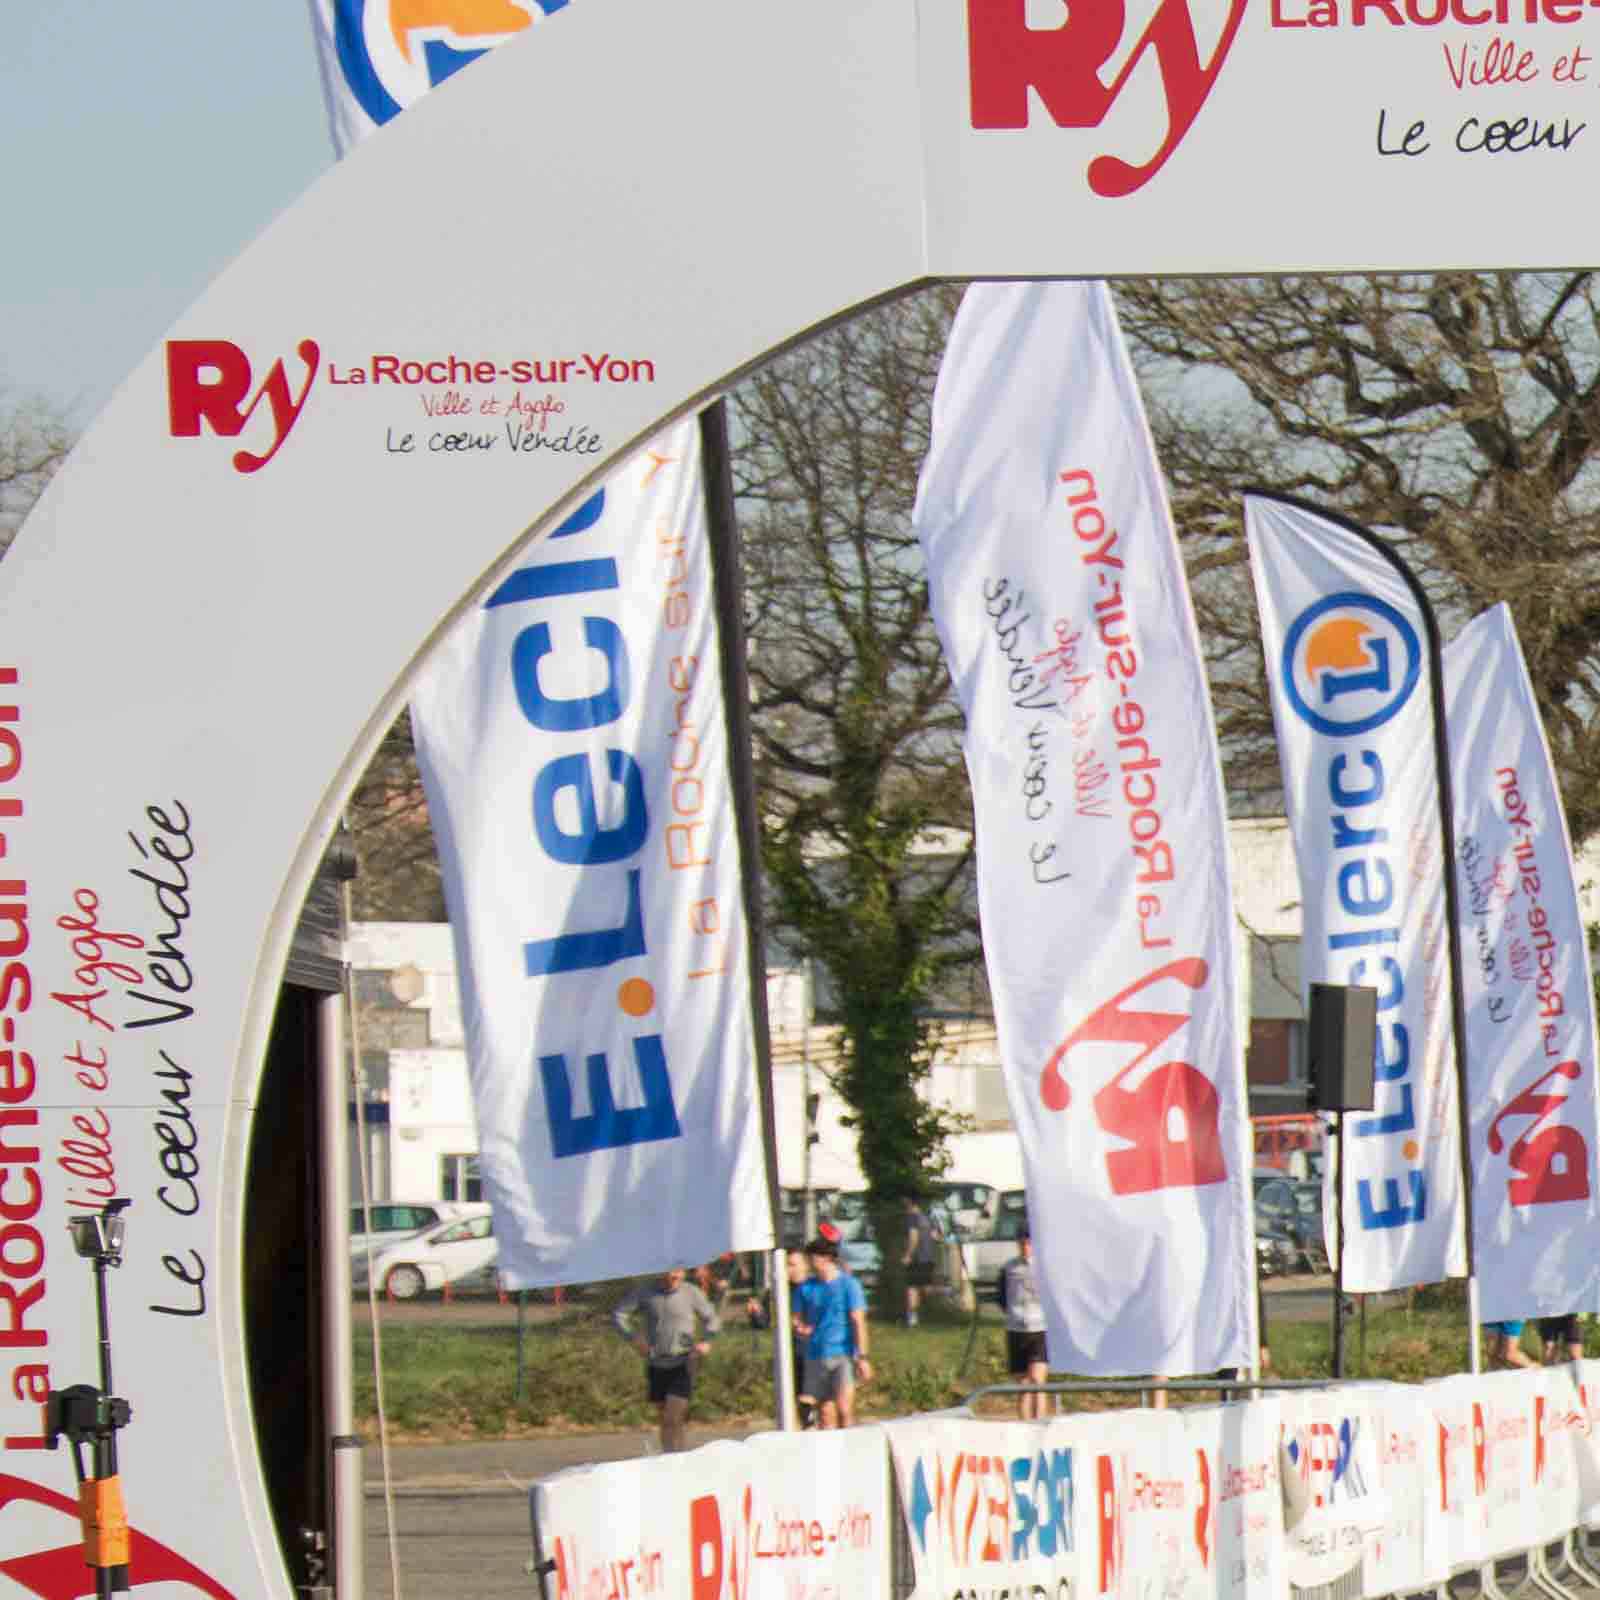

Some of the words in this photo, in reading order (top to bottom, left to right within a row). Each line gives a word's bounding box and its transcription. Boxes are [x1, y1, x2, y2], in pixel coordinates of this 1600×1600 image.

[1444, 40, 1539, 89] Ville
[1552, 47, 1594, 84] et
[1377, 108, 1431, 157] Le
[328, 363, 367, 385] La
[371, 353, 656, 386] Roche-sur-Yon
[166, 339, 320, 473] Ry
[421, 391, 473, 417] Ville
[478, 396, 502, 415] et
[505, 392, 567, 431] Agglo
[386, 426, 418, 454] Le
[505, 423, 603, 455] Vendée
[484, 488, 682, 1160] E.Lecl
[122, 798, 195, 1030] Vendée
[50, 886, 146, 1033] Agglo
[59, 1038, 110, 1092] et
[149, 1247, 206, 1318] Le
